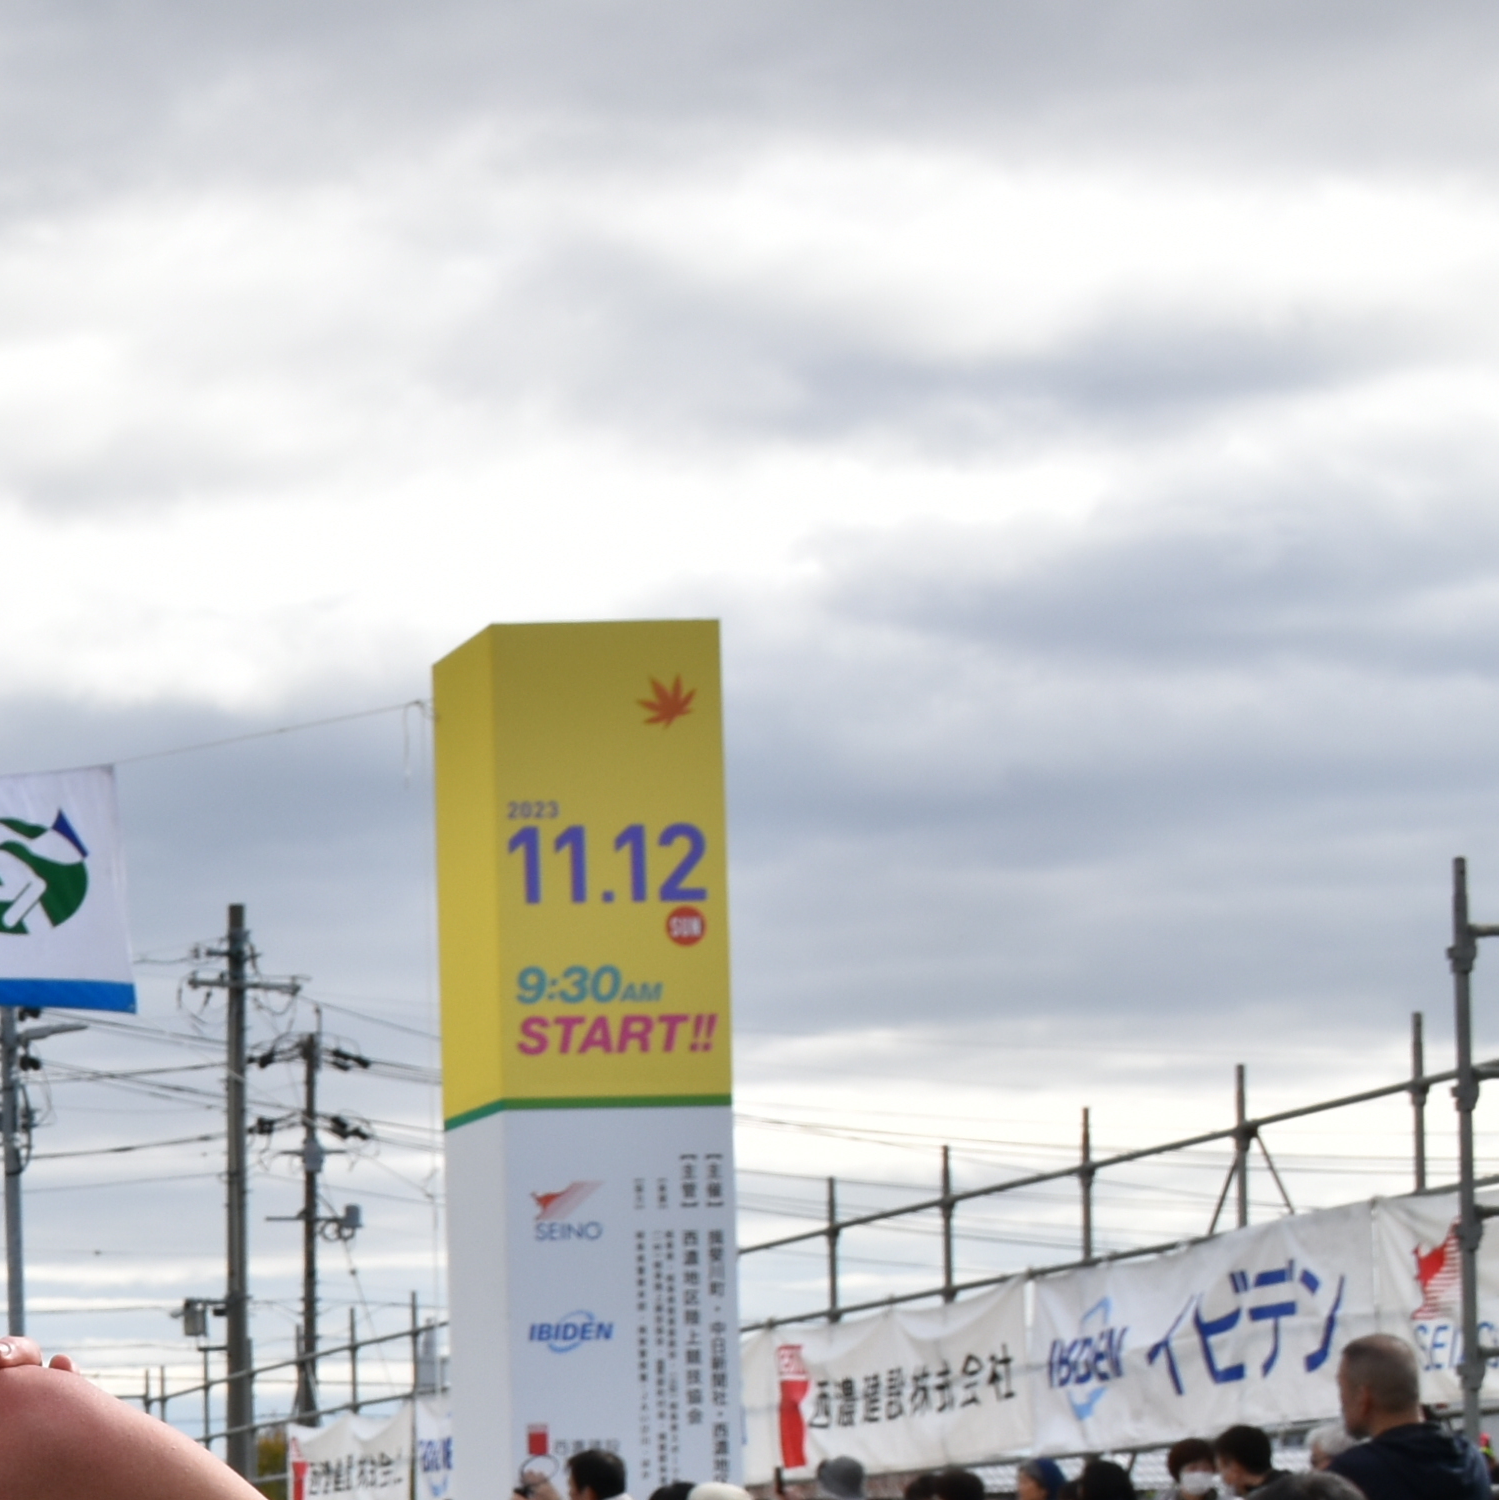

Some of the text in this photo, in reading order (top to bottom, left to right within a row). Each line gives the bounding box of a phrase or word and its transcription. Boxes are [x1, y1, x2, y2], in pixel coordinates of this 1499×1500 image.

[507, 801, 560, 820] 2023
[508, 823, 708, 905] 11.12
[669, 917, 702, 938] SUN
[516, 1013, 719, 1056] START!!
[534, 1221, 604, 1242] SEINO
[529, 1321, 615, 1343] IBIDEN
[1145, 1258, 1346, 1396] イビデン
